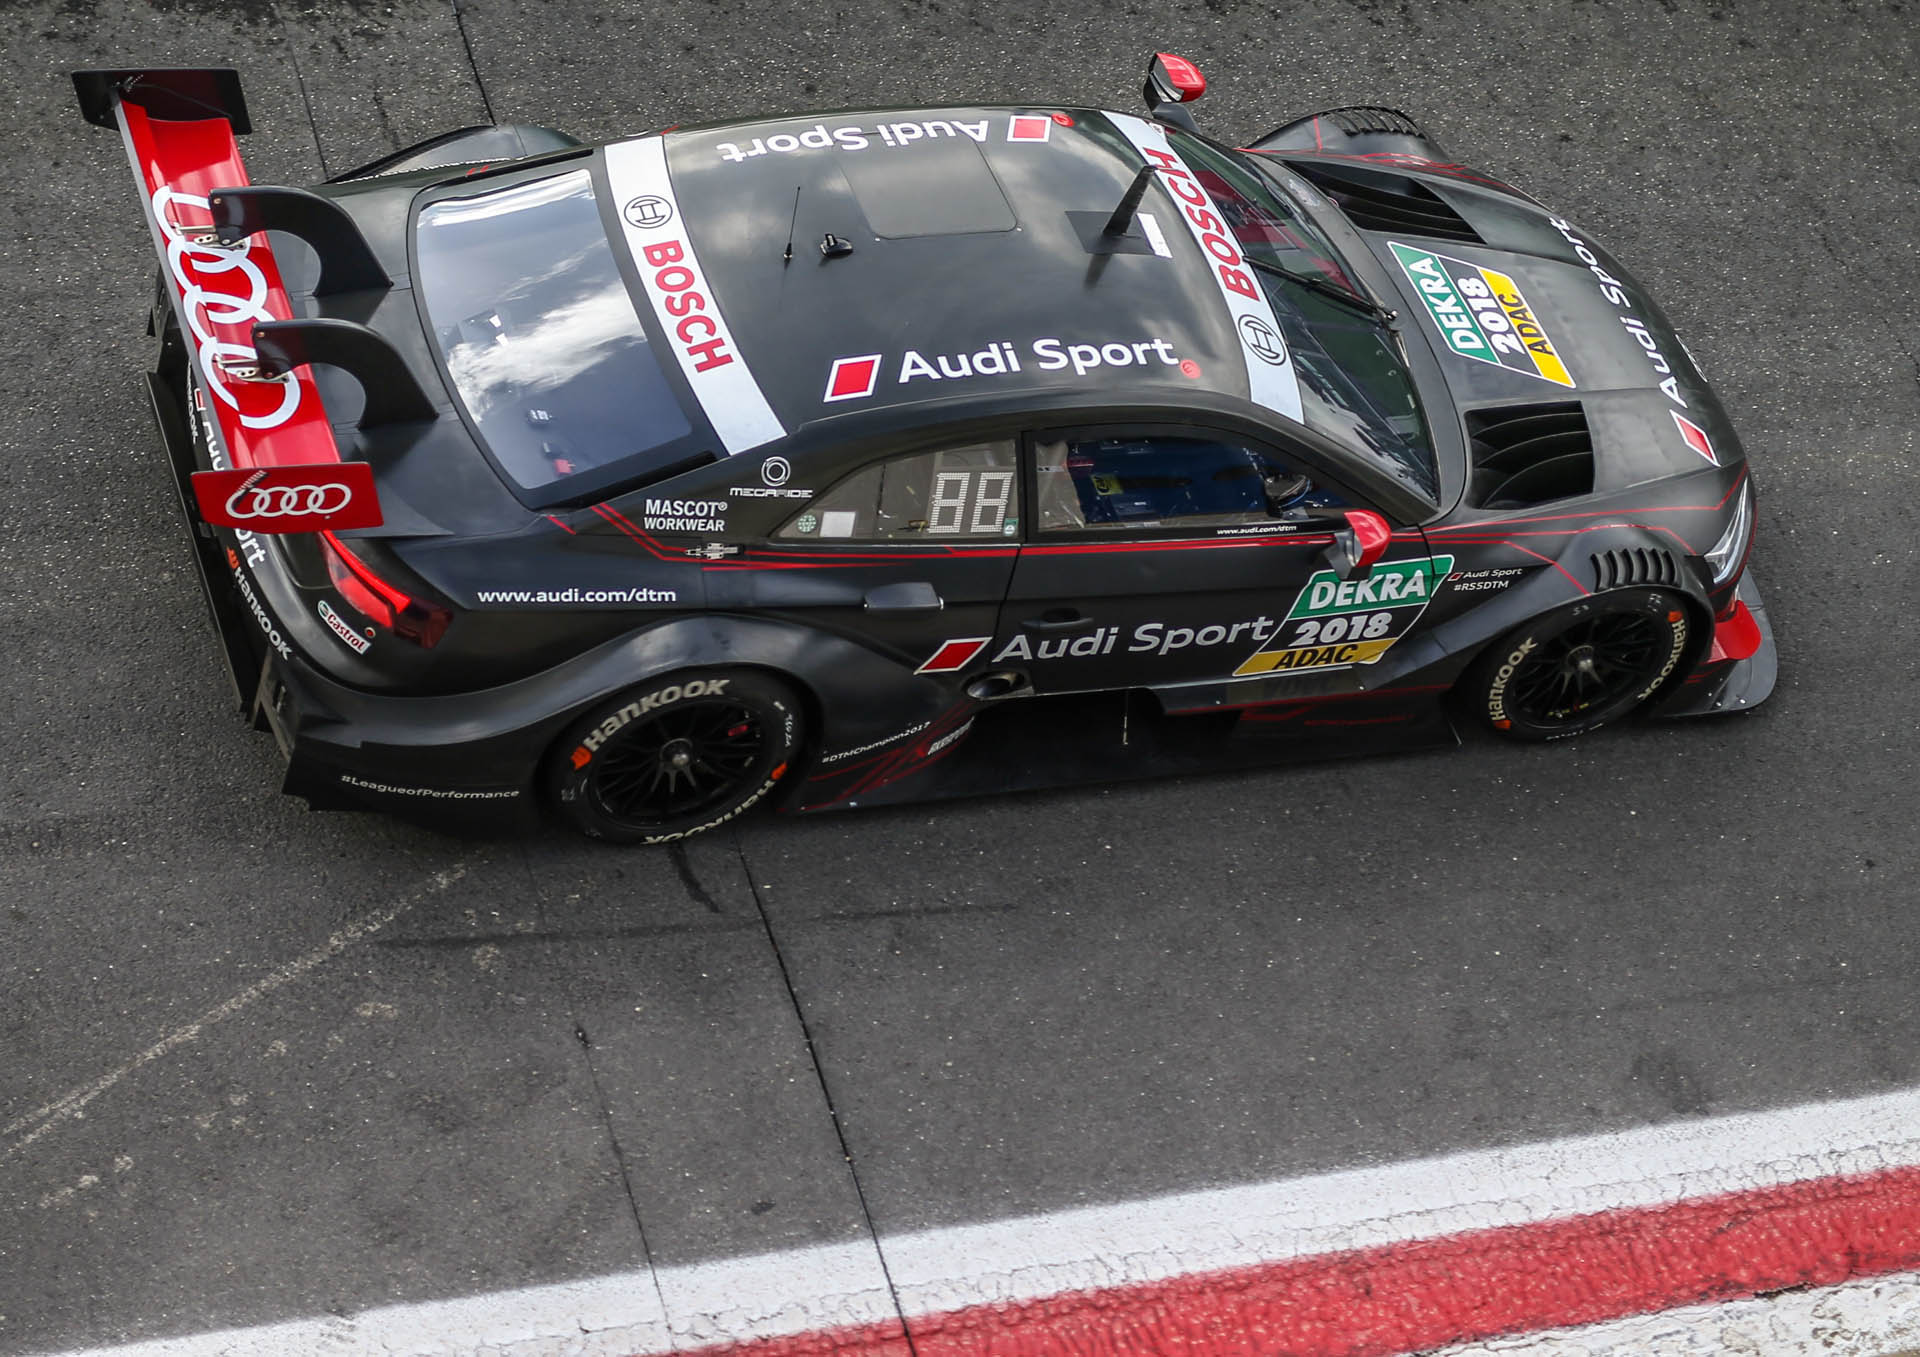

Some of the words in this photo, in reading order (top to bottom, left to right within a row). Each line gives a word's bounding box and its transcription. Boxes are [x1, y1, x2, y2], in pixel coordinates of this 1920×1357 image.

[716, 124, 869, 162] Sport
[878, 119, 989, 146] Audi
[1143, 147, 1260, 302] BOSCH
[1549, 217, 1631, 308] Sport
[642, 239, 734, 374] BOSCH
[1408, 257, 1485, 350] DEKRA
[1458, 277, 1526, 356] 2018
[1498, 293, 1555, 357] ADAC
[899, 342, 1021, 384] Audi
[1032, 338, 1179, 376] Sport
[1620, 316, 1688, 409] Audi
[644, 517, 725, 532] WORKWEAR
[1217, 525, 1297, 536] www.audi.com/dtm
[1308, 570, 1427, 611] DEKRA
[1463, 570, 1493, 579] Audi
[1495, 568, 1523, 579] Sport
[477, 588, 676, 604] www.audi.com/dtm
[326, 613, 365, 651] Castrol
[992, 626, 1119, 663] Audi
[1128, 616, 1274, 656] Sport
[1288, 612, 1393, 647] 2018
[1273, 644, 1360, 671] ADAC
[341, 775, 520, 799] #LeagueofPerformance
